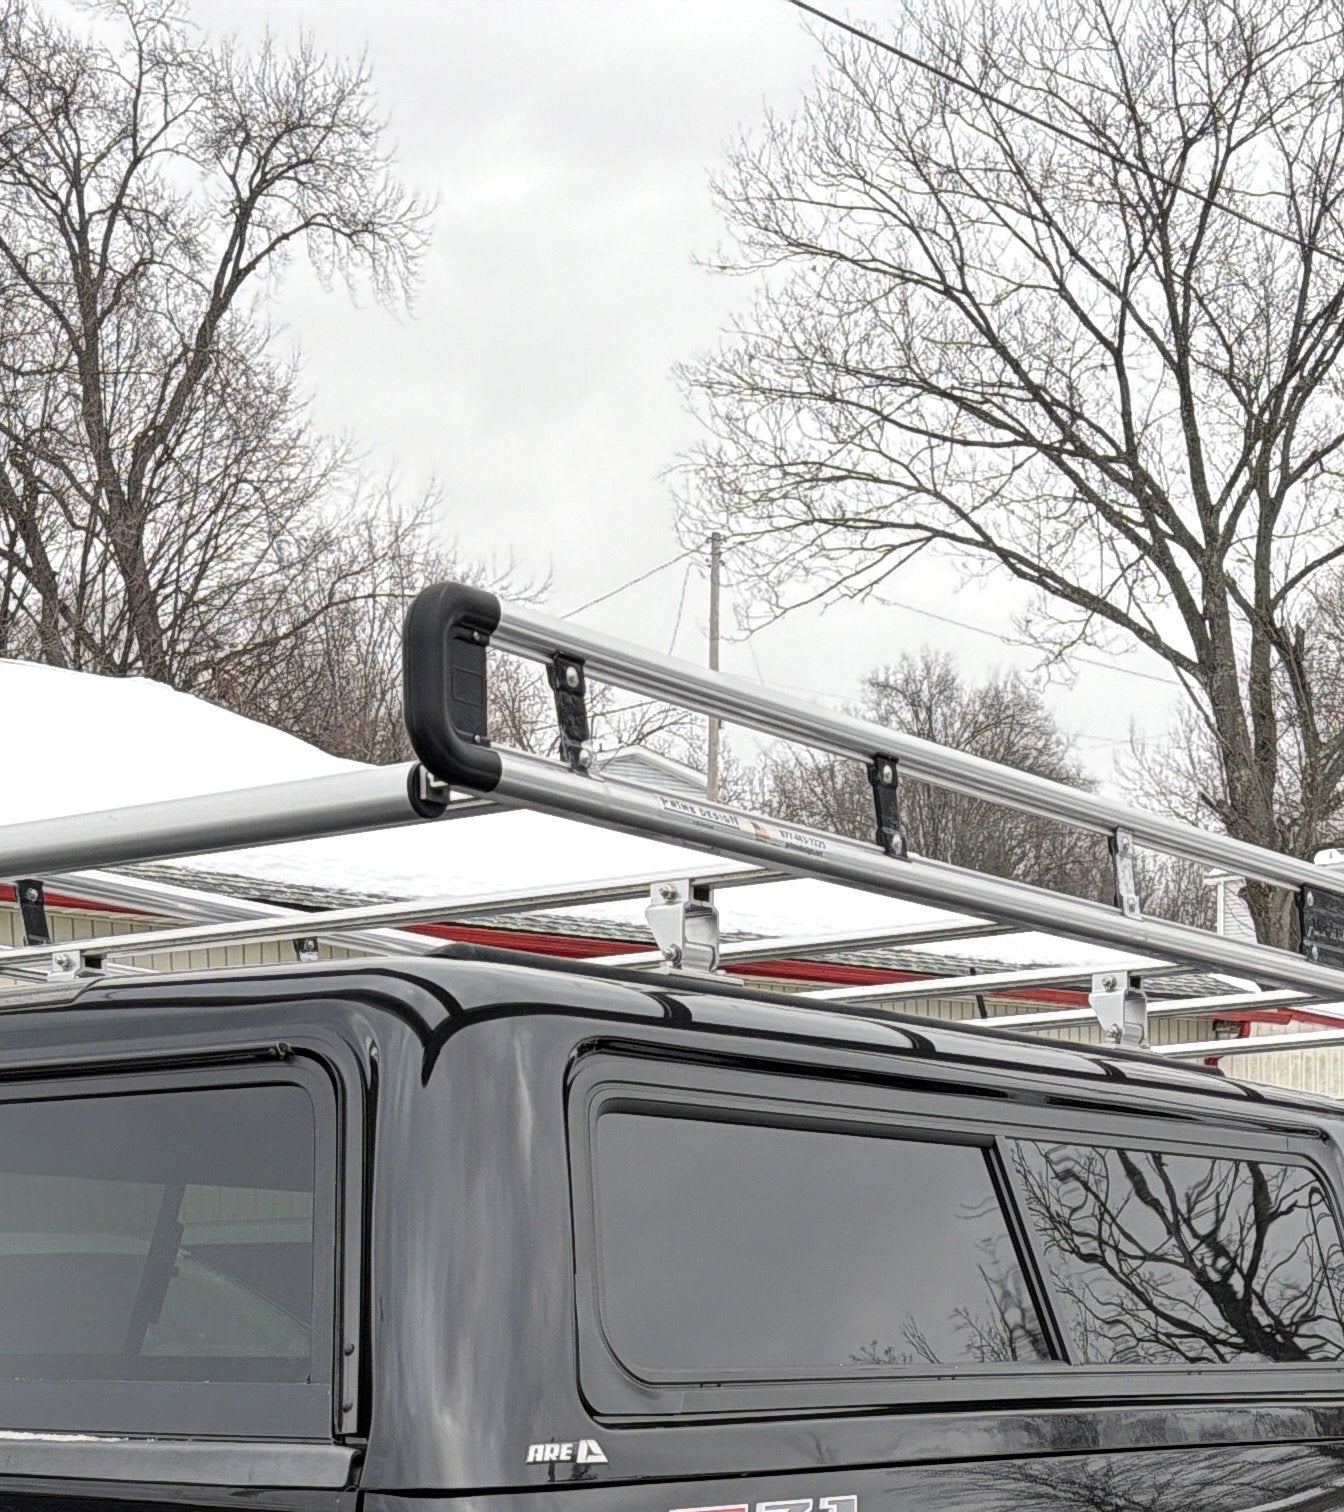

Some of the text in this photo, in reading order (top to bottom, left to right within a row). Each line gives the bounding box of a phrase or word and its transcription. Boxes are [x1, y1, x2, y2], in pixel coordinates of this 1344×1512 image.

[658, 796, 696, 815] PRIME
[699, 808, 740, 828] DESIGN
[525, 1440, 574, 1464] ARE
